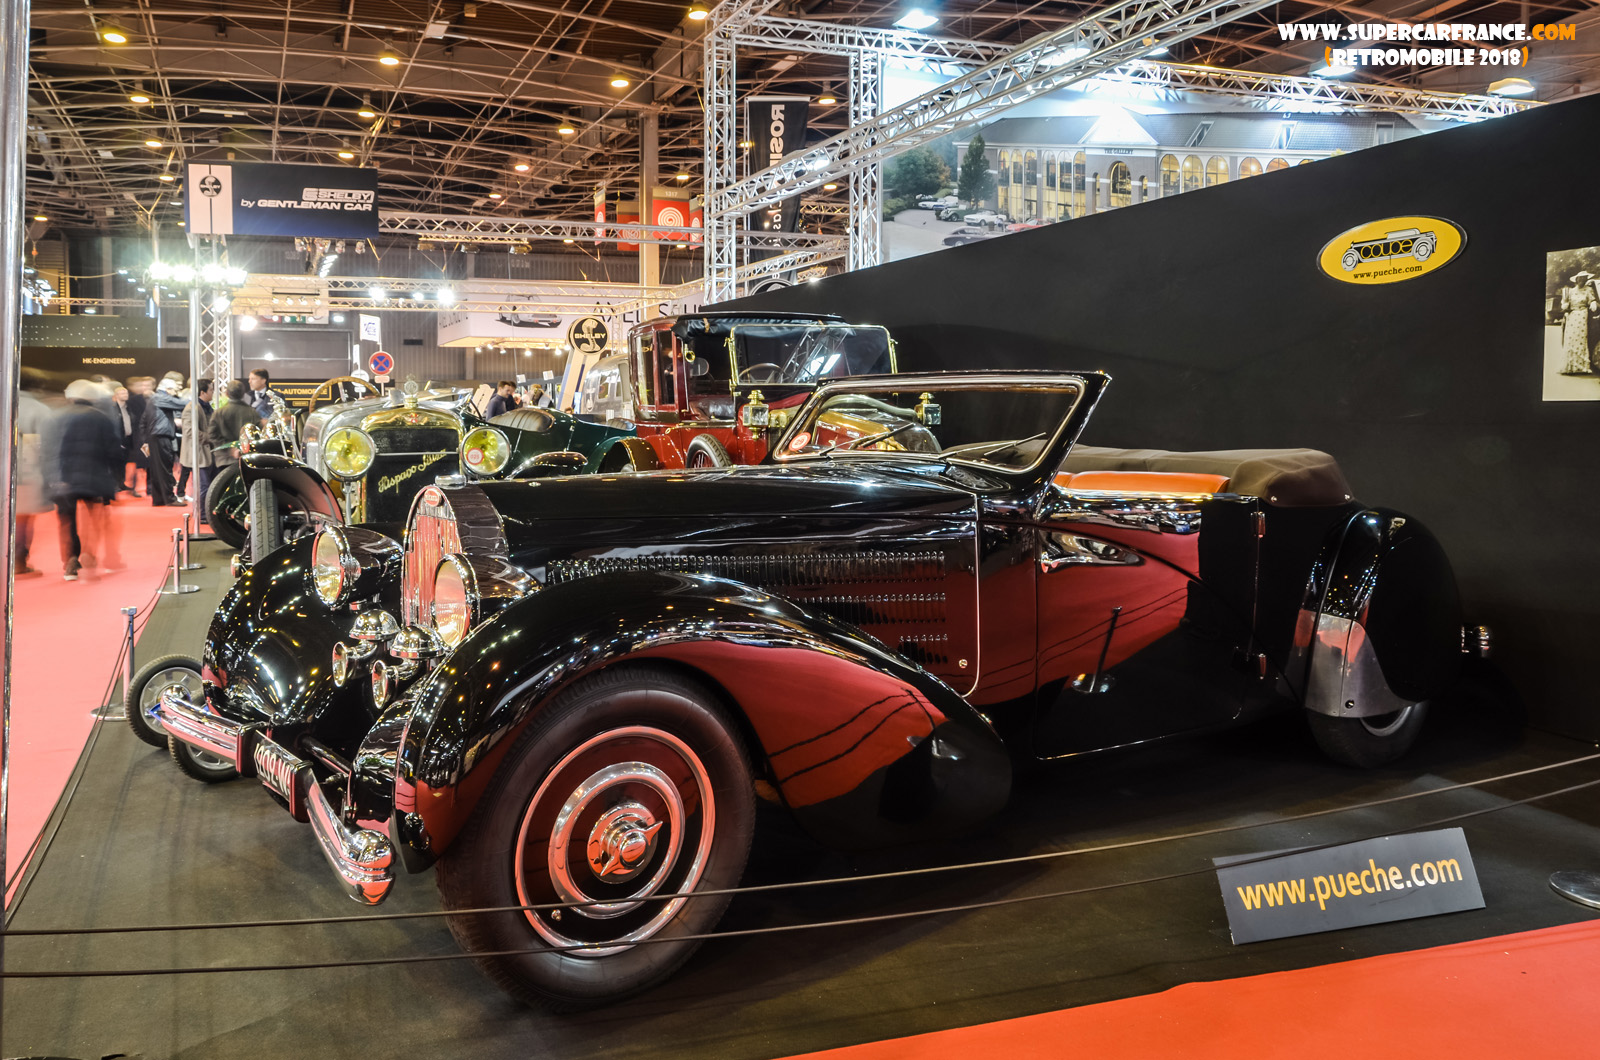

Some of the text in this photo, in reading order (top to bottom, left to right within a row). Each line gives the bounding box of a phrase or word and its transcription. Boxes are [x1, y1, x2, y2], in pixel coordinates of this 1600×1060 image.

[318, 191, 371, 200] SHELBY
[240, 198, 255, 208] by
[257, 199, 341, 210] GENTLEMAN
[344, 202, 373, 212] CAR
[1353, 265, 1423, 279] www.pueche.com
[82, 357, 136, 365] HK-ENGINEERING
[1236, 858, 1464, 911] www.pueche.com
